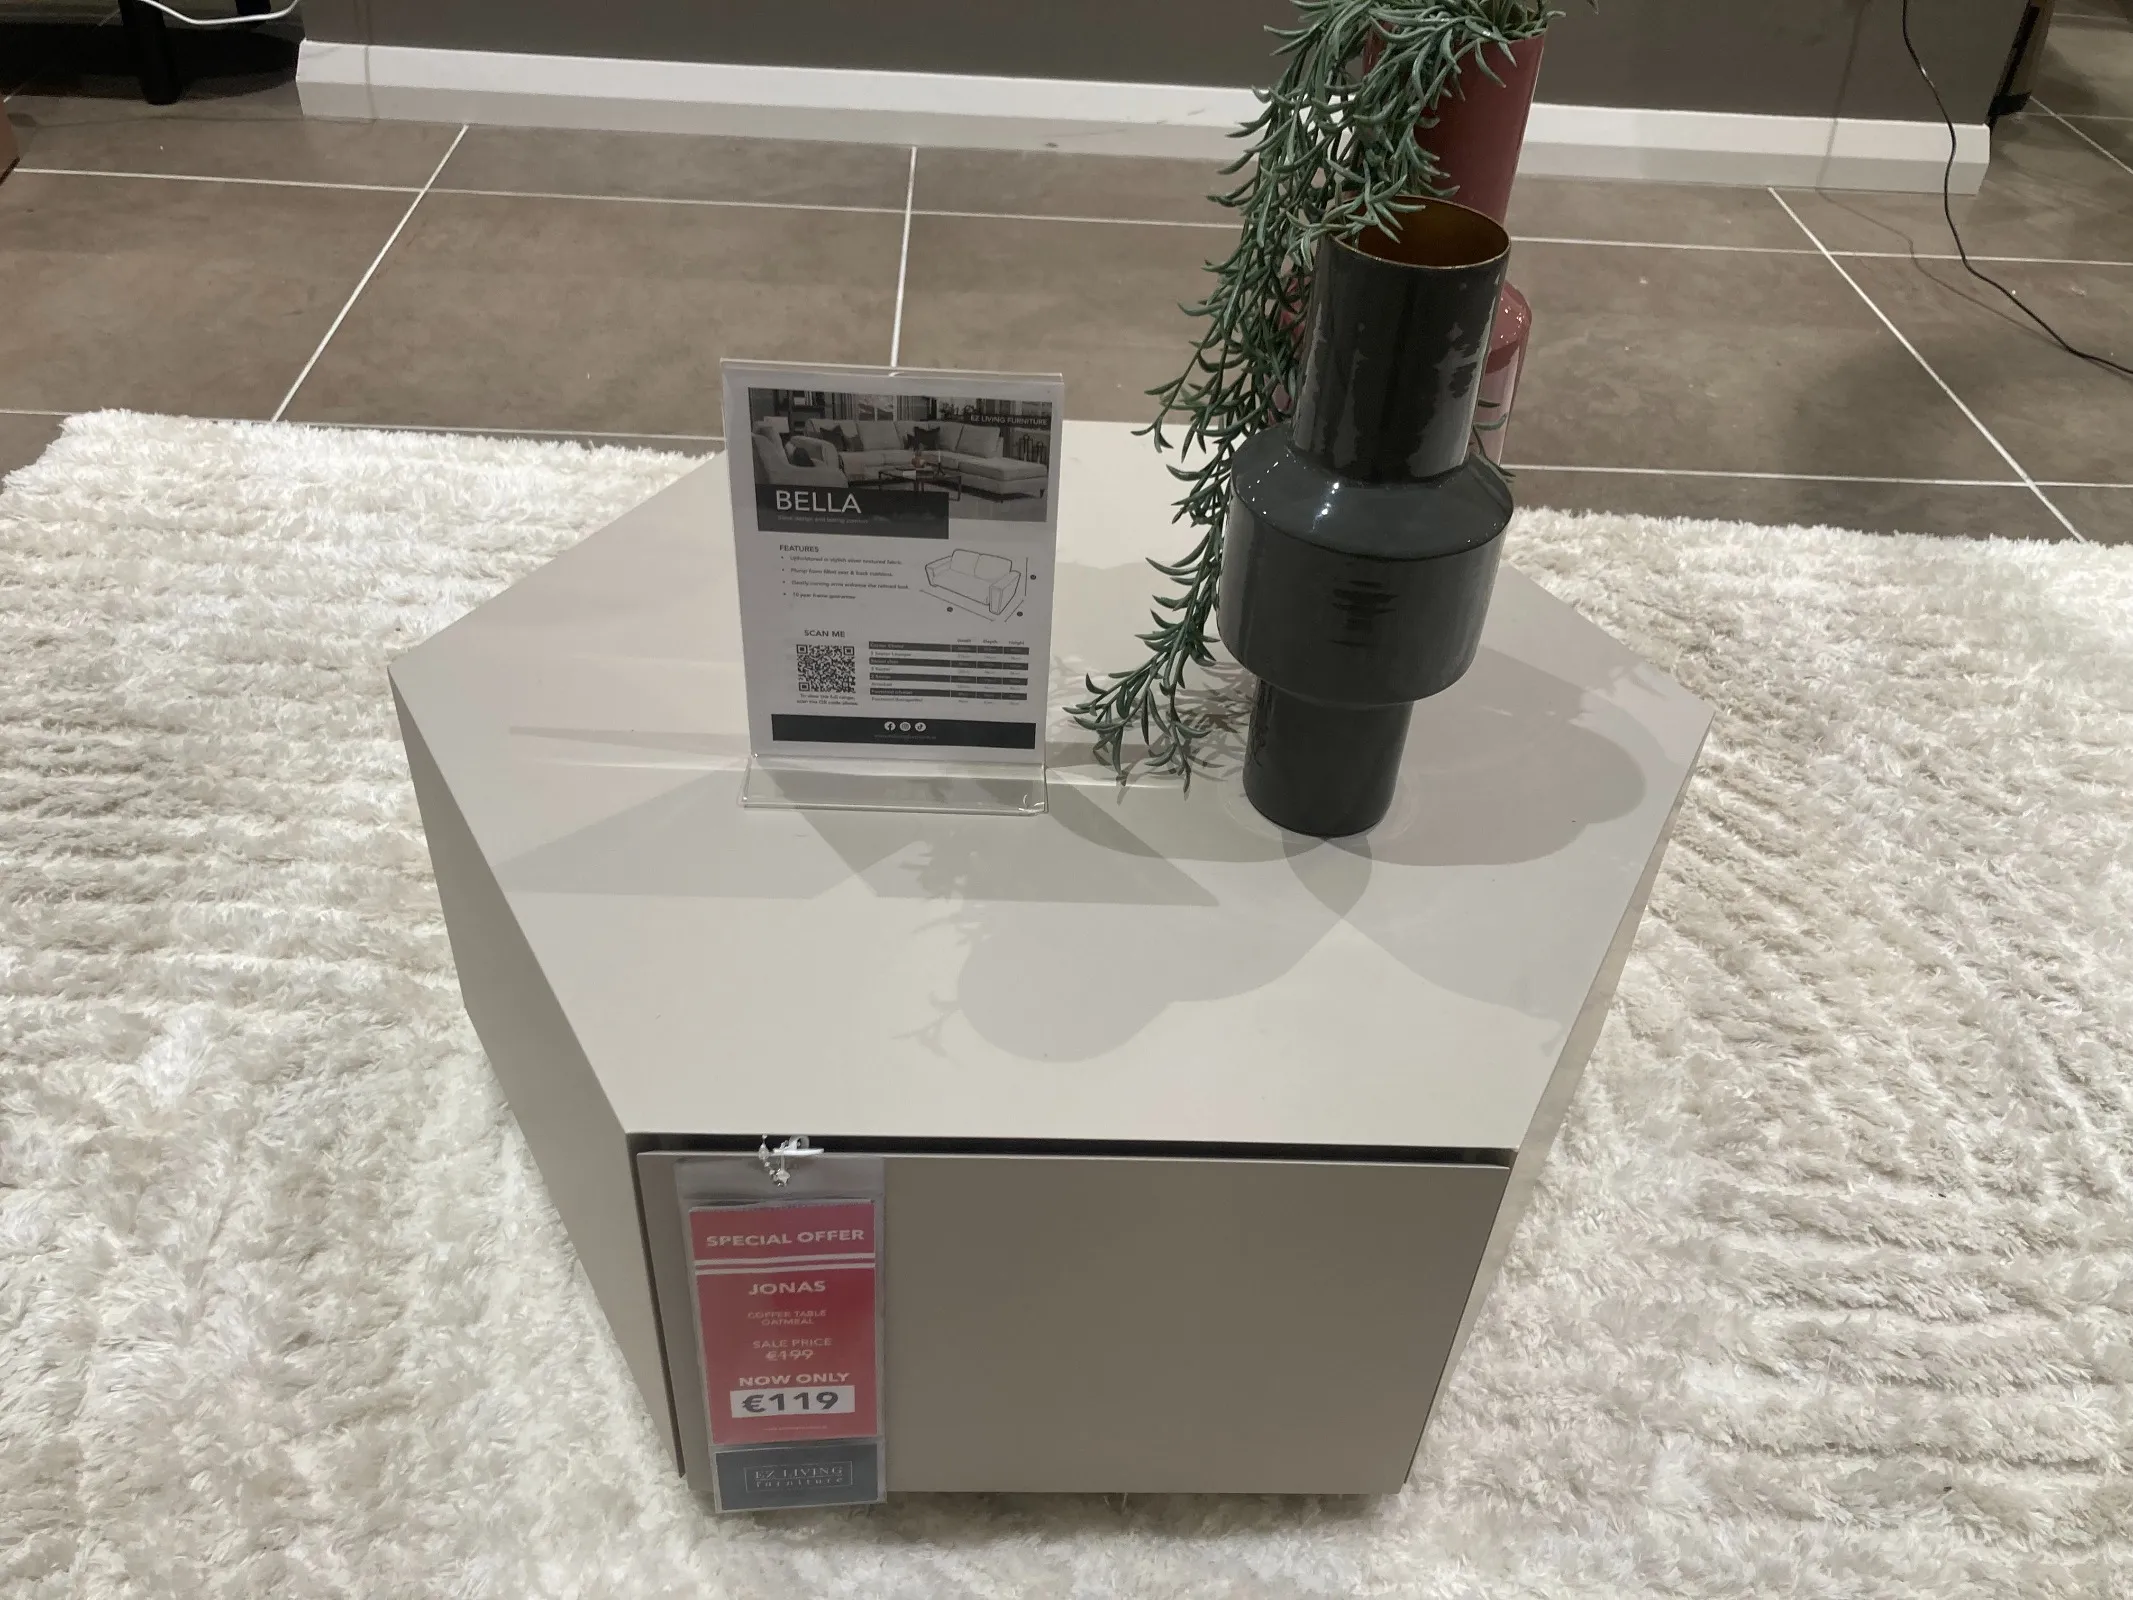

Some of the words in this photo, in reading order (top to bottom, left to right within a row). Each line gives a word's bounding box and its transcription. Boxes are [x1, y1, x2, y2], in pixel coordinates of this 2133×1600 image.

[981, 415, 1006, 424] LIVING
[1007, 417, 1048, 425] FURNITURE
[775, 490, 862, 513] BELLA
[779, 544, 819, 553] FEATURES
[804, 629, 829, 637] SCAN
[831, 630, 845, 638] ME
[706, 1233, 792, 1247] SPECIAL
[797, 1229, 865, 1244] OFFER
[748, 1280, 826, 1296] JONAS
[747, 1311, 792, 1319] COFFEE
[794, 1309, 828, 1318] TABLE
[761, 1318, 815, 1326] OATMEAL
[753, 1339, 789, 1350] SALE
[791, 1337, 833, 1348] PRICE
[765, 1349, 814, 1362] €199
[739, 1374, 791, 1387] NOW
[796, 1372, 850, 1383] ONLY
[741, 1391, 839, 1413] €119
[755, 1470, 776, 1480] EZ
[783, 1466, 844, 1478] LIVING
